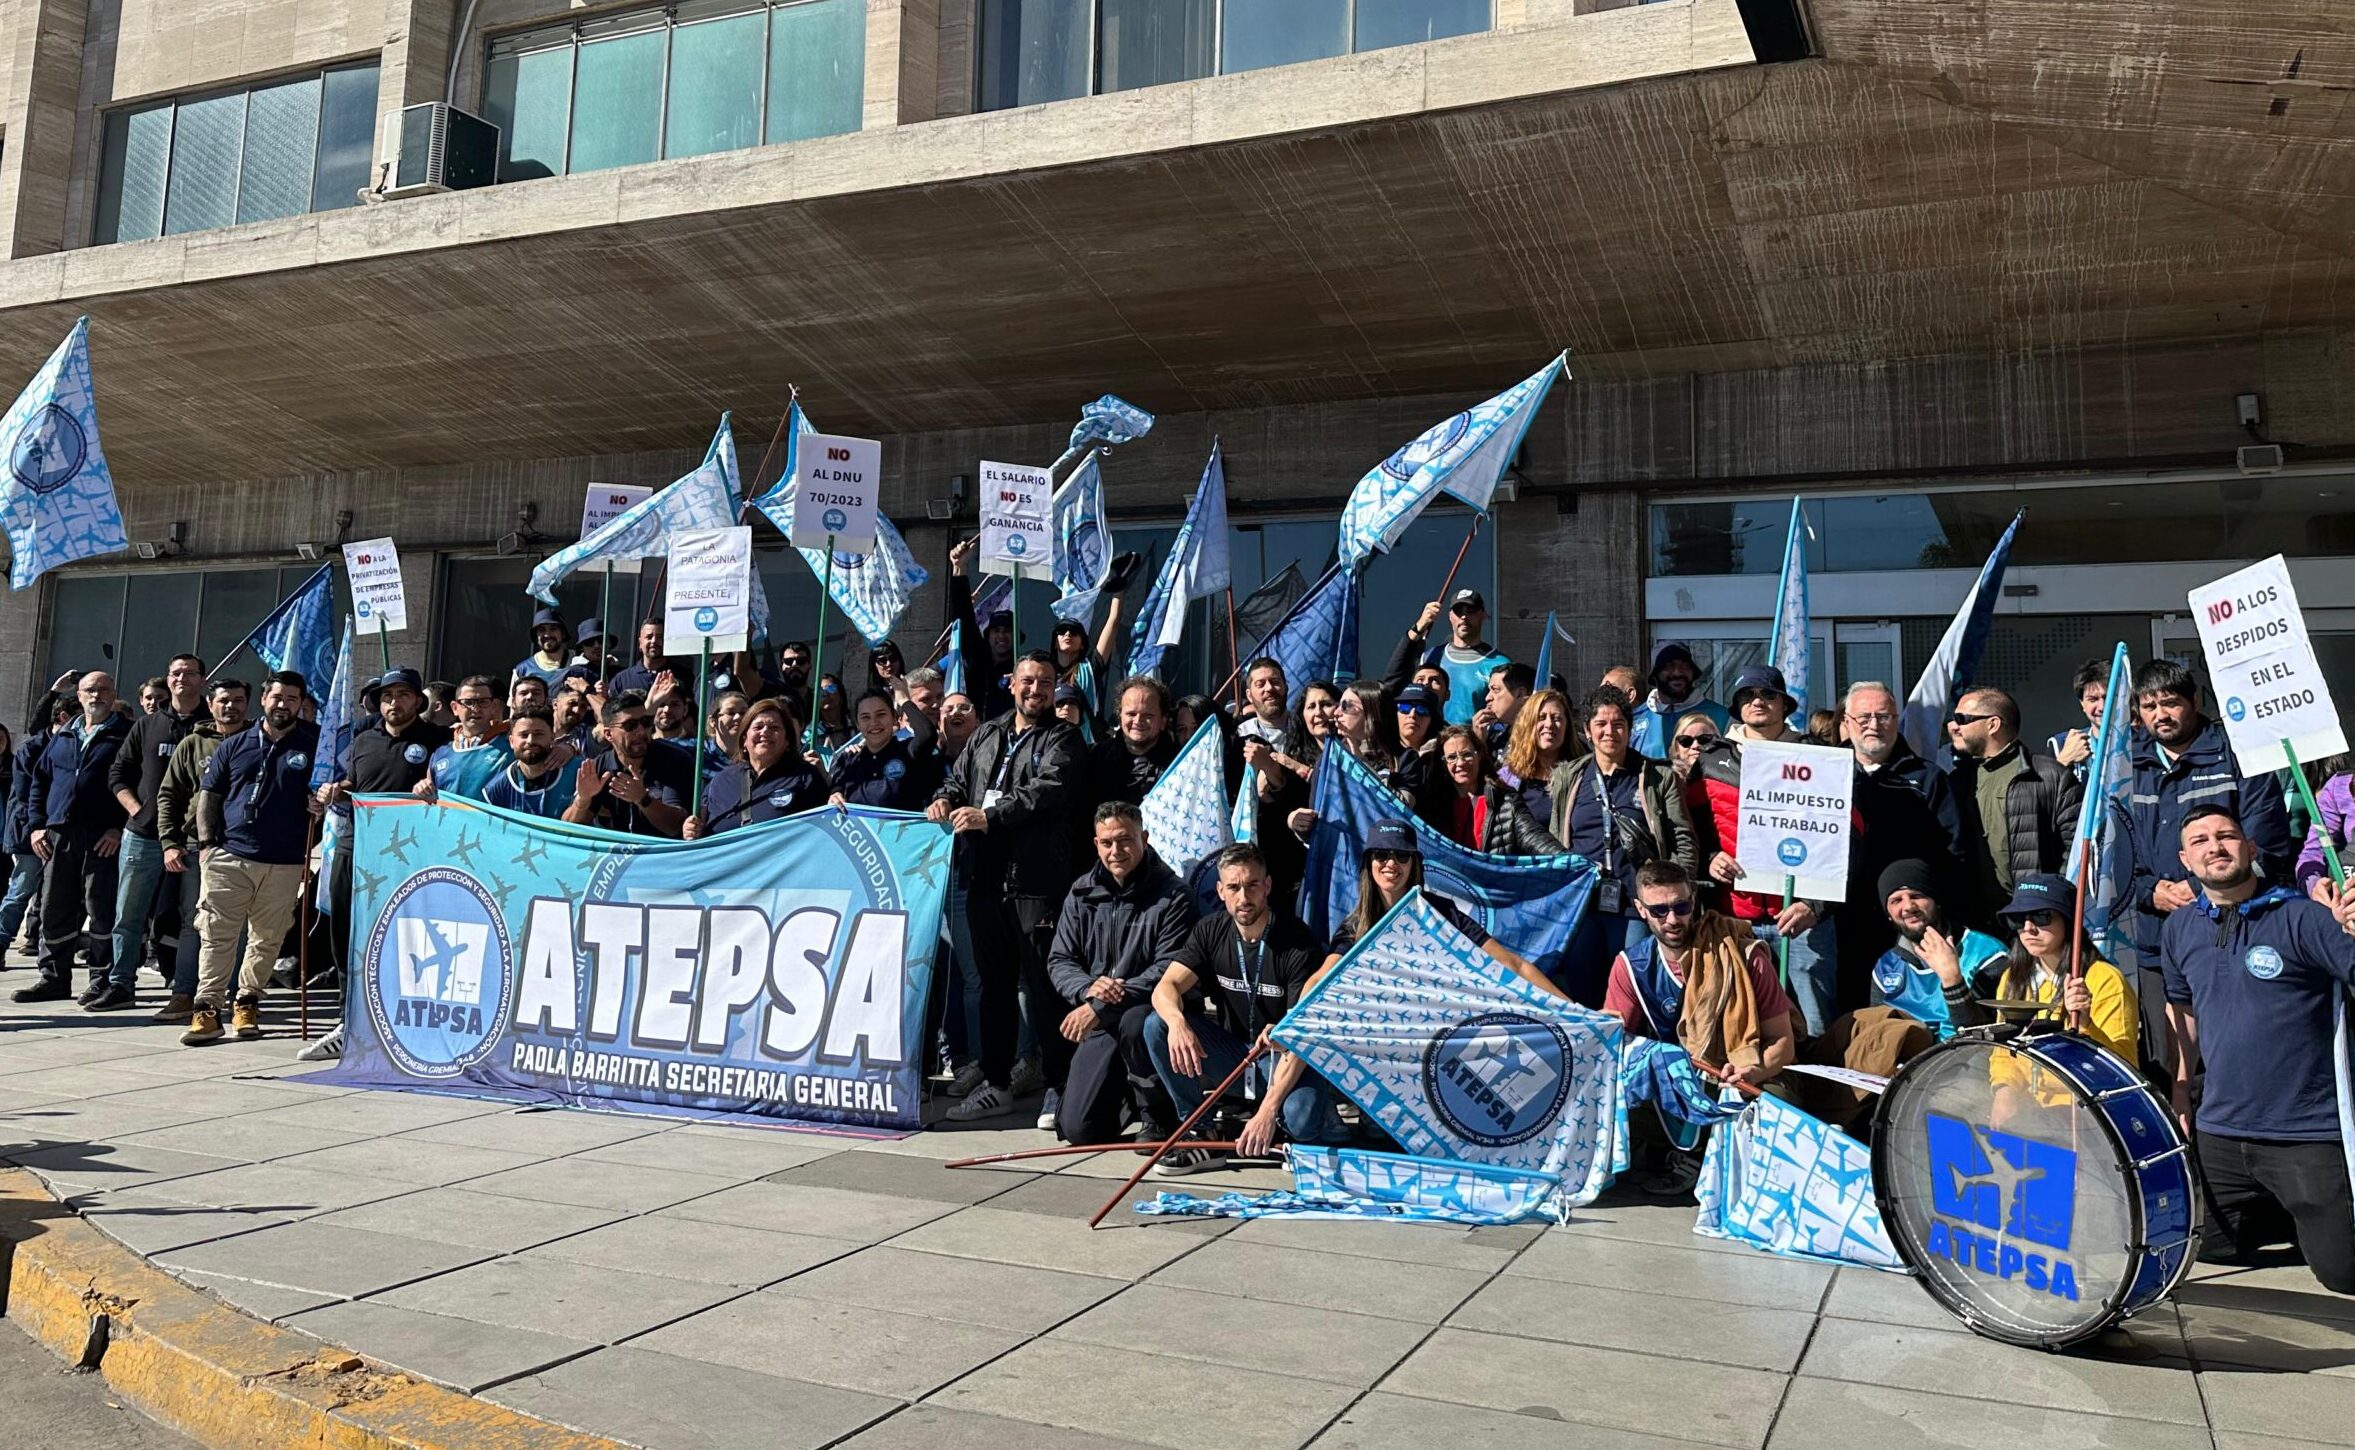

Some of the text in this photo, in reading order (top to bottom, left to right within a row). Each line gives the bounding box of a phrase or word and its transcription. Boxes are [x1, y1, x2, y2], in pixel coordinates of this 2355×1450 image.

[828, 447, 850, 461] NO
[812, 468, 862, 483] AL DNU
[986, 470, 1046, 486] EL SALARIO
[610, 495, 628, 505] NO
[809, 492, 862, 506] 70/2023
[1000, 491, 1032, 504] NO ES
[588, 510, 599, 518] AL
[989, 518, 1044, 532] GANANCIA
[357, 554, 371, 565] NO
[378, 554, 386, 562] LA
[680, 554, 737, 565] PATAGONIA
[352, 567, 398, 580] PRIVATIZACIÓN
[356, 582, 399, 594] DE EMPRESAS
[370, 594, 402, 604] PÚBLICAS
[2208, 586, 2278, 624] NO A LOS
[2216, 618, 2288, 656] DESPIDOS
[2250, 662, 2294, 686] EN EL
[2254, 688, 2314, 719] ESTADO
[1782, 764, 1812, 782] NO
[1746, 789, 1845, 810] AL IMPUESTO
[1748, 814, 1839, 834] AL TRABAJO
[416, 874, 428, 884] DE
[428, 871, 473, 888] PROTECCIÓN
[473, 884, 479, 892] Y
[382, 880, 416, 926] EMPLEADOS
[478, 888, 506, 938] SEGURIDAD
[501, 940, 508, 948] A
[368, 932, 383, 982] TÉCNICOS
[503, 948, 510, 962] LA
[514, 896, 909, 1065] ATEPSA
[392, 1044, 428, 1072] PERSONERÍA
[512, 1042, 567, 1076] PAOLA
[572, 1050, 660, 1088] BARRITTA
[666, 1064, 788, 1102] SECRETARIA
[794, 1075, 898, 1112] GENERAL
[1440, 1056, 1516, 1132] ATEPSA
[1926, 1218, 2080, 1303] ATEPSA
